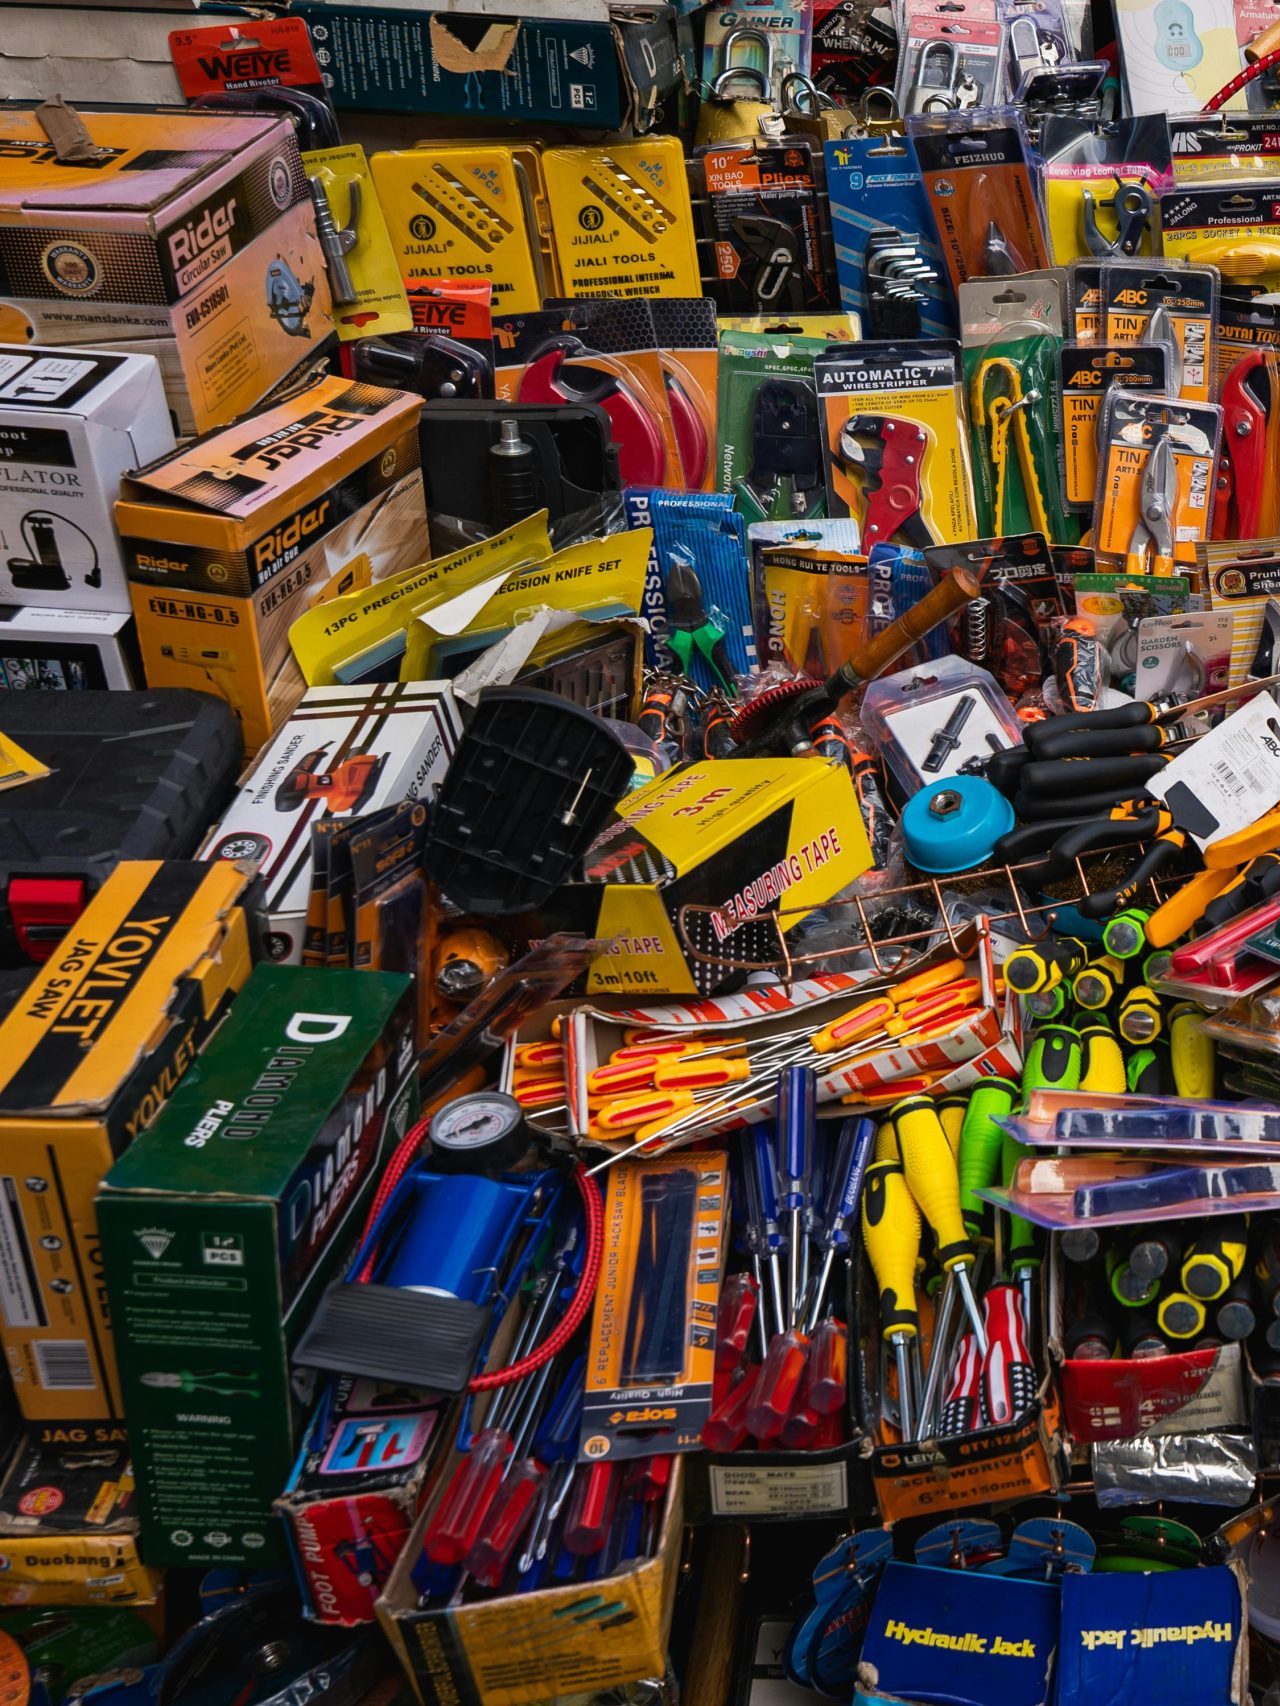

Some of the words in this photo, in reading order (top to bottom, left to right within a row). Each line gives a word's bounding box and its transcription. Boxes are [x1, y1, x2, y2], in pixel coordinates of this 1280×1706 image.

[197, 49, 291, 80] WEIYE
[226, 80, 247, 90] Hand
[249, 77, 280, 88] Riveter
[953, 151, 1006, 165] FEIZHUO
[708, 172, 721, 182] XIN
[723, 171, 743, 180] BAO
[762, 172, 812, 186] Pliers
[1207, 215, 1263, 225] Professional
[169, 198, 237, 269] Rider
[571, 233, 613, 245] JIJIALI
[1166, 231, 1197, 241] 24PCS
[1202, 228, 1242, 240] SOCKET
[404, 243, 446, 255] JIJIALI
[181, 257, 210, 285] Circular
[211, 245, 227, 264] Saw
[574, 256, 607, 267] JIALI
[612, 252, 655, 264] TOOLS
[408, 266, 442, 278] JIALI
[448, 263, 492, 275] TOOLS
[572, 275, 633, 287] PROFESSIONAL
[625, 285, 660, 296] WRENCH
[1113, 289, 1148, 305] ABC
[1114, 317, 1139, 330] TIN
[822, 367, 922, 385] AUTOMATIC
[927, 366, 945, 379] 7"
[1067, 371, 1102, 386] ABC
[843, 378, 927, 391] WIRESTRIPPER
[1071, 399, 1095, 412] TIN
[257, 414, 364, 471] Rider
[1116, 449, 1141, 464] TIN
[52, 489, 85, 498] QUALITY
[255, 502, 329, 572] Rider
[135, 554, 189, 572] Rider
[554, 565, 592, 582] KNIFE
[597, 559, 621, 572] SET
[773, 556, 797, 567] HONG
[799, 561, 813, 570] RUI
[816, 563, 828, 572] TE
[830, 564, 860, 574] TOOLS
[323, 612, 359, 637] 13PC
[362, 572, 440, 616] PRECISION
[443, 547, 486, 576] KNIFE
[489, 533, 516, 551] SET
[149, 599, 240, 624] EVA-HG-0.5
[769, 590, 786, 653] HONG
[1140, 635, 1178, 645] GARDEN
[1140, 641, 1182, 651] SCISSORS
[251, 762, 285, 806] FINISHING
[278, 733, 306, 769] SANDER
[416, 734, 444, 791] SANDER
[711, 856, 803, 941] MEASURING
[801, 826, 842, 873] TAPE
[622, 936, 664, 954] TAPE
[59, 938, 99, 973] JAG
[49, 914, 171, 1040] YOVLET
[593, 971, 658, 986] 3m/10ft
[26, 976, 72, 1020] SAW
[183, 1099, 235, 1149] PLIERS
[597, 1293, 614, 1371] REPLACEMENT
[606, 1255, 619, 1290] JUNIOR
[616, 1166, 628, 1198] BLADE
[610, 1390, 650, 1400] Quality
[656, 1389, 684, 1398] High
[176, 1412, 232, 1425] WARNING
[42, 1429, 89, 1443] JAG
[318, 1569, 340, 1615] FOOT
[885, 1619, 987, 1654] Hydraulic
[989, 1637, 1036, 1658] Jack
[1081, 1630, 1125, 1650] Jack
[1131, 1622, 1232, 1648] Hydraulic
